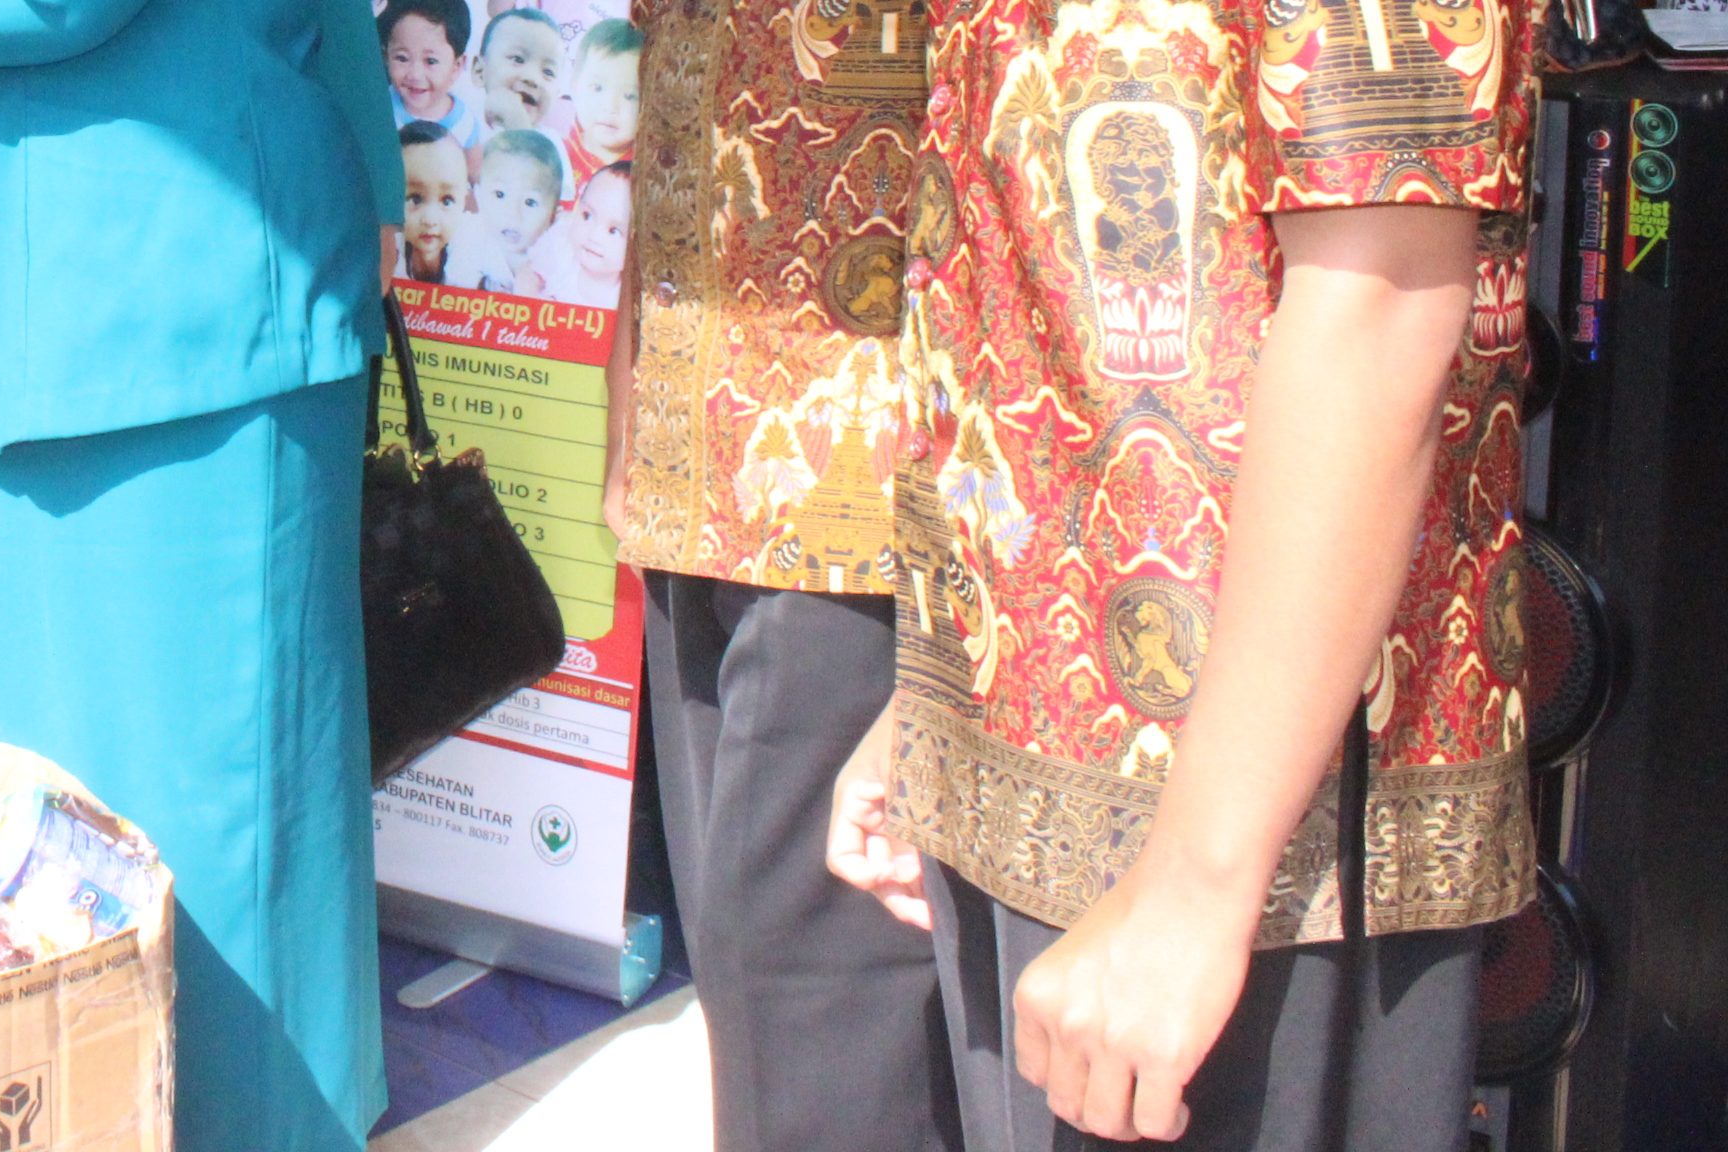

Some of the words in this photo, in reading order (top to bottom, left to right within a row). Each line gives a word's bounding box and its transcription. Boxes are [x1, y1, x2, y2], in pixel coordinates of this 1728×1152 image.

[1629, 200, 1670, 217] best
[1629, 214, 1669, 226] SOUND
[1628, 222, 1669, 240] BOX
[1580, 250, 1599, 303] sound
[393, 285, 426, 307] sar
[430, 288, 532, 326] Lengkap
[1573, 303, 1595, 343] best
[481, 324, 490, 344] 1
[496, 327, 550, 351] tahun
[445, 354, 550, 386] IMUNISASI
[432, 392, 446, 407] B
[464, 397, 494, 415] HB
[512, 406, 523, 420] 0
[448, 433, 456, 446] 1
[488, 479, 530, 498] OLIO
[536, 488, 547, 503] 2
[534, 526, 544, 541] 3
[532, 697, 541, 710] 3
[539, 677, 592, 699] munisasi
[594, 688, 631, 708] dasar
[498, 711, 531, 731] dosis
[533, 722, 590, 745] pertama
[395, 768, 474, 798] ESEHATAN
[377, 782, 455, 813] ABUPATEN
[459, 802, 513, 828] BLITAR
